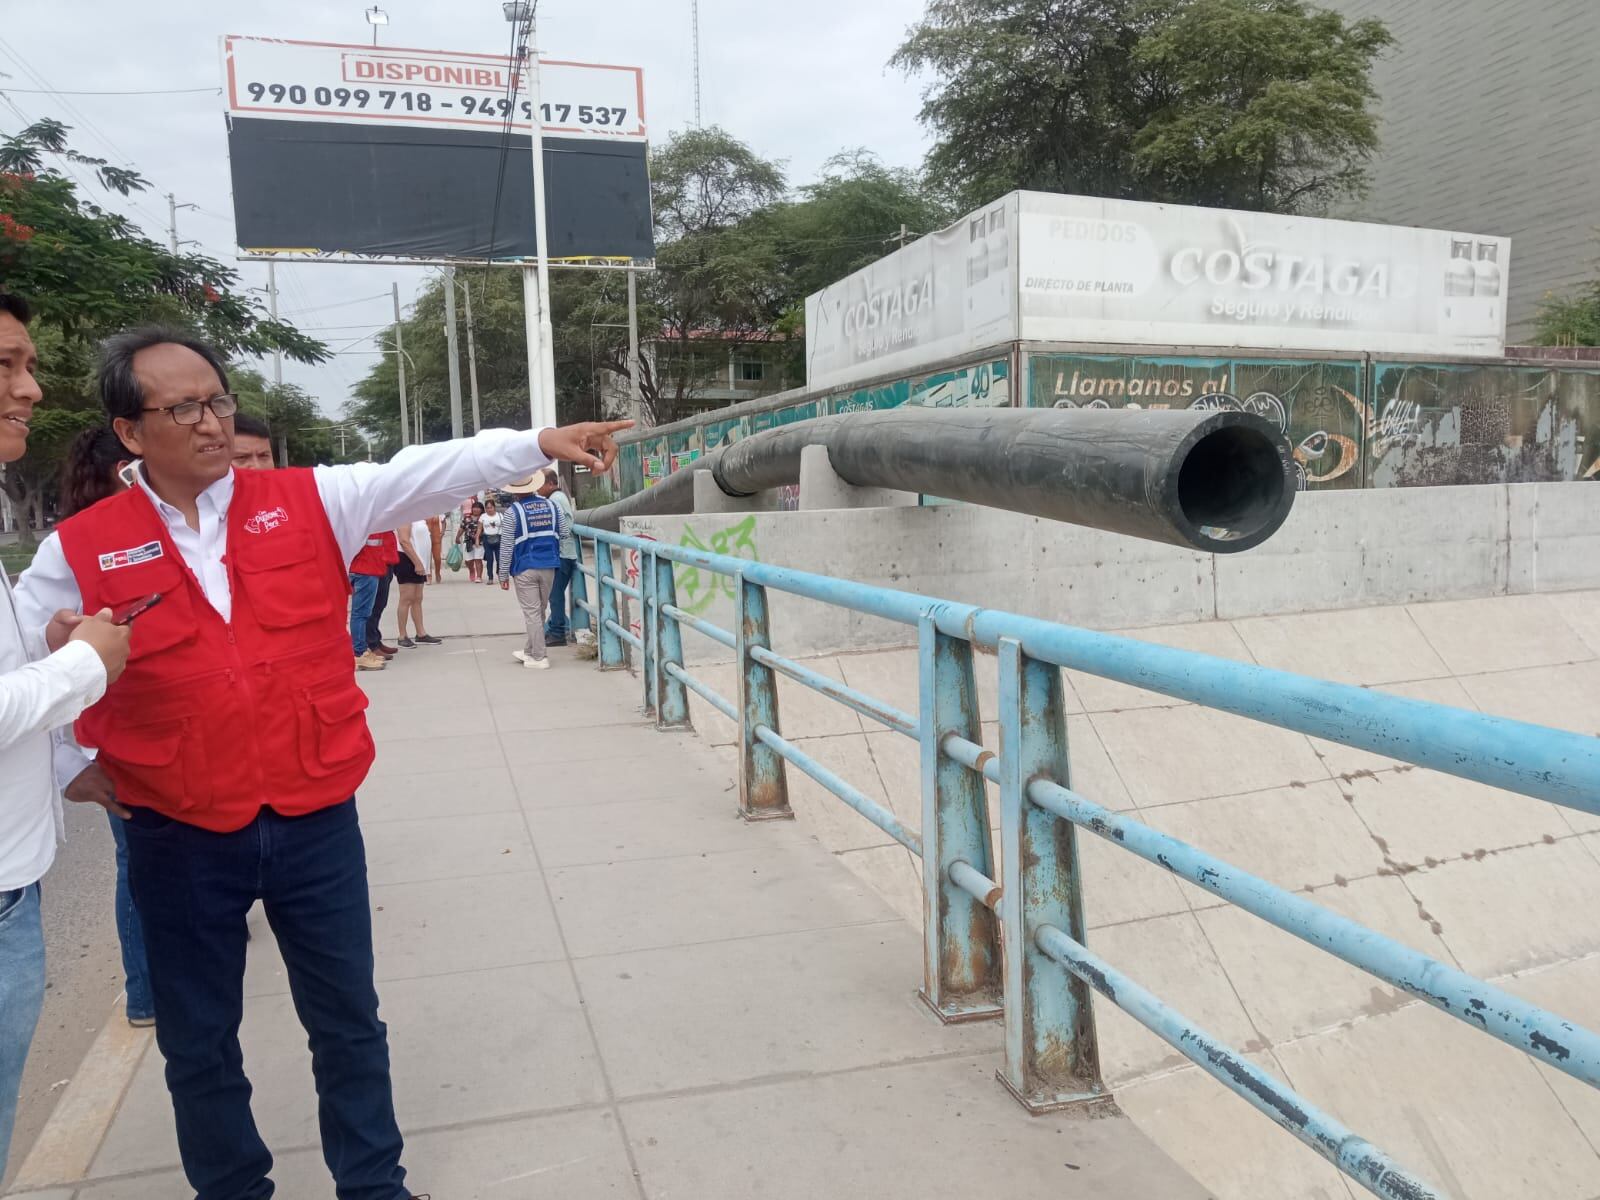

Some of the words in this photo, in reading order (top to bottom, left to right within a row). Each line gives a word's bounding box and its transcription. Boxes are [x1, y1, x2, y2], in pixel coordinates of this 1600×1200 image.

[247, 82, 307, 105] 990
[314, 87, 370, 109] 099
[379, 90, 432, 112] 718
[460, 96, 512, 118] 949
[579, 106, 627, 126] 537
[1050, 219, 1137, 243] PEDIDOS
[1025, 276, 1074, 291] DIRECTO
[1077, 279, 1091, 291] DE
[1094, 280, 1134, 294] PLANTA
[1211, 297, 1280, 320] Seguro
[1283, 303, 1295, 321] y
[1054, 371, 1194, 397] Llamanos
